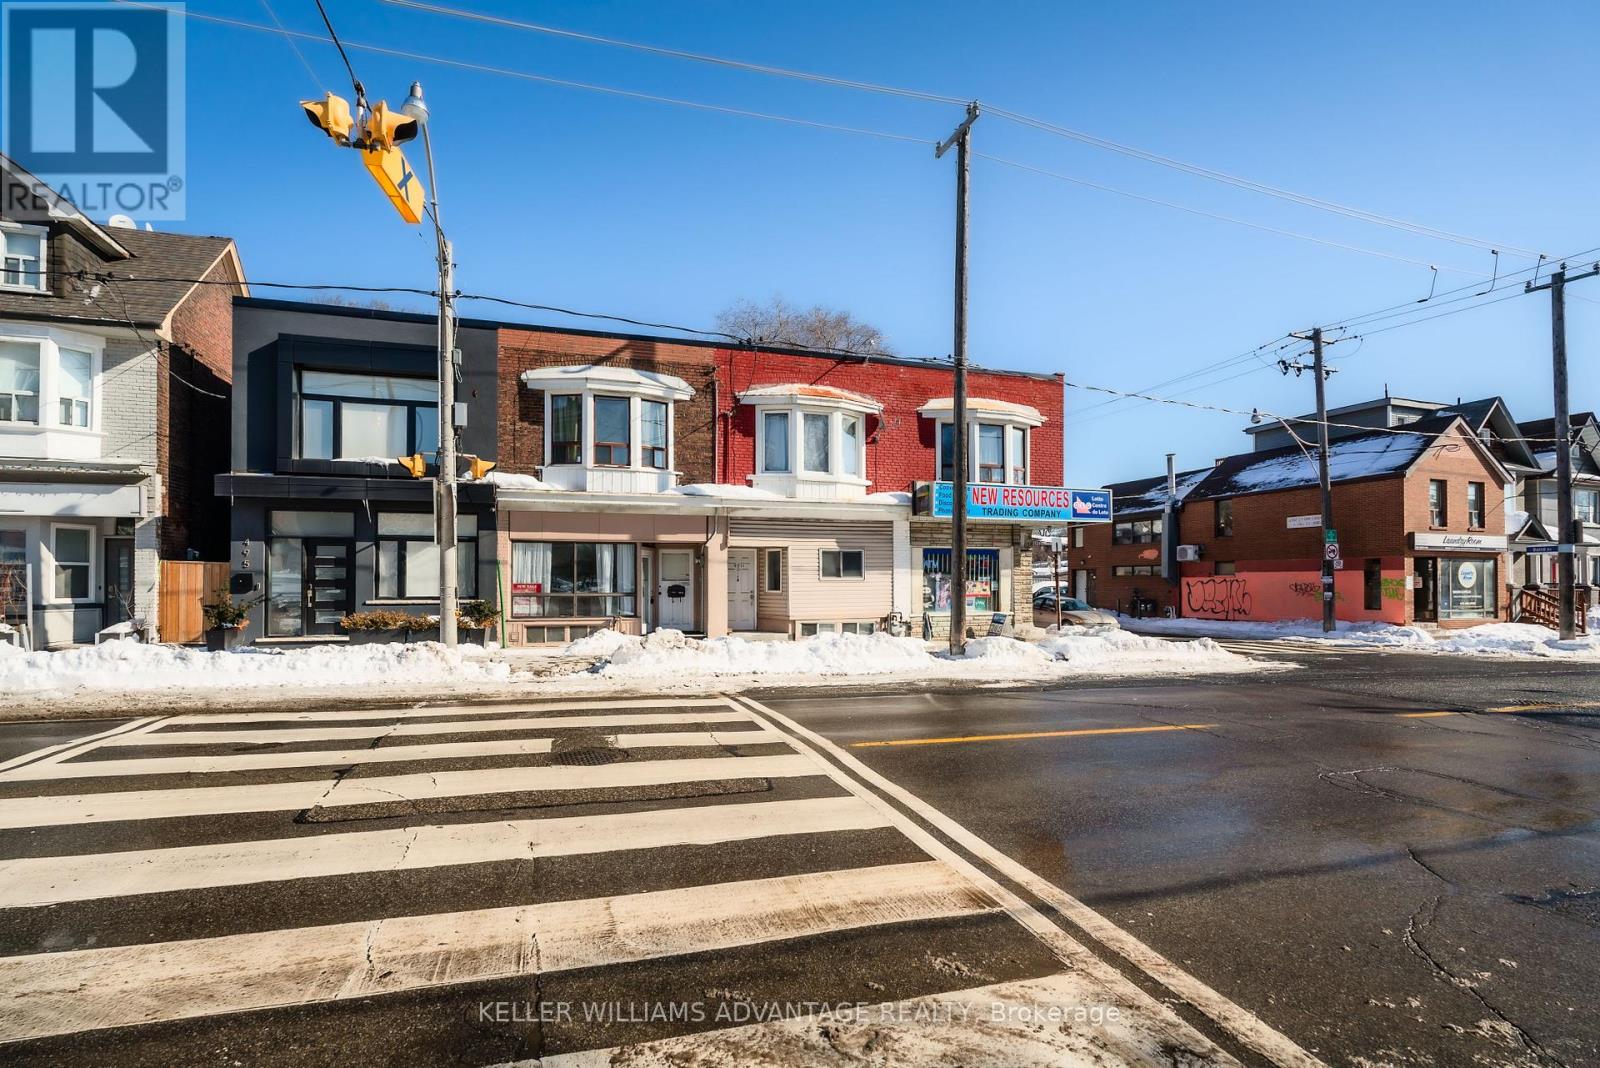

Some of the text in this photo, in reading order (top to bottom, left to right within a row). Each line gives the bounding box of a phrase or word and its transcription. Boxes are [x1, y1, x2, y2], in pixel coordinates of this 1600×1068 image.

[972, 486, 1069, 508] NEW RESOURCES
[982, 507, 1019, 517] TRADING
[1022, 508, 1061, 518] COMPANY
